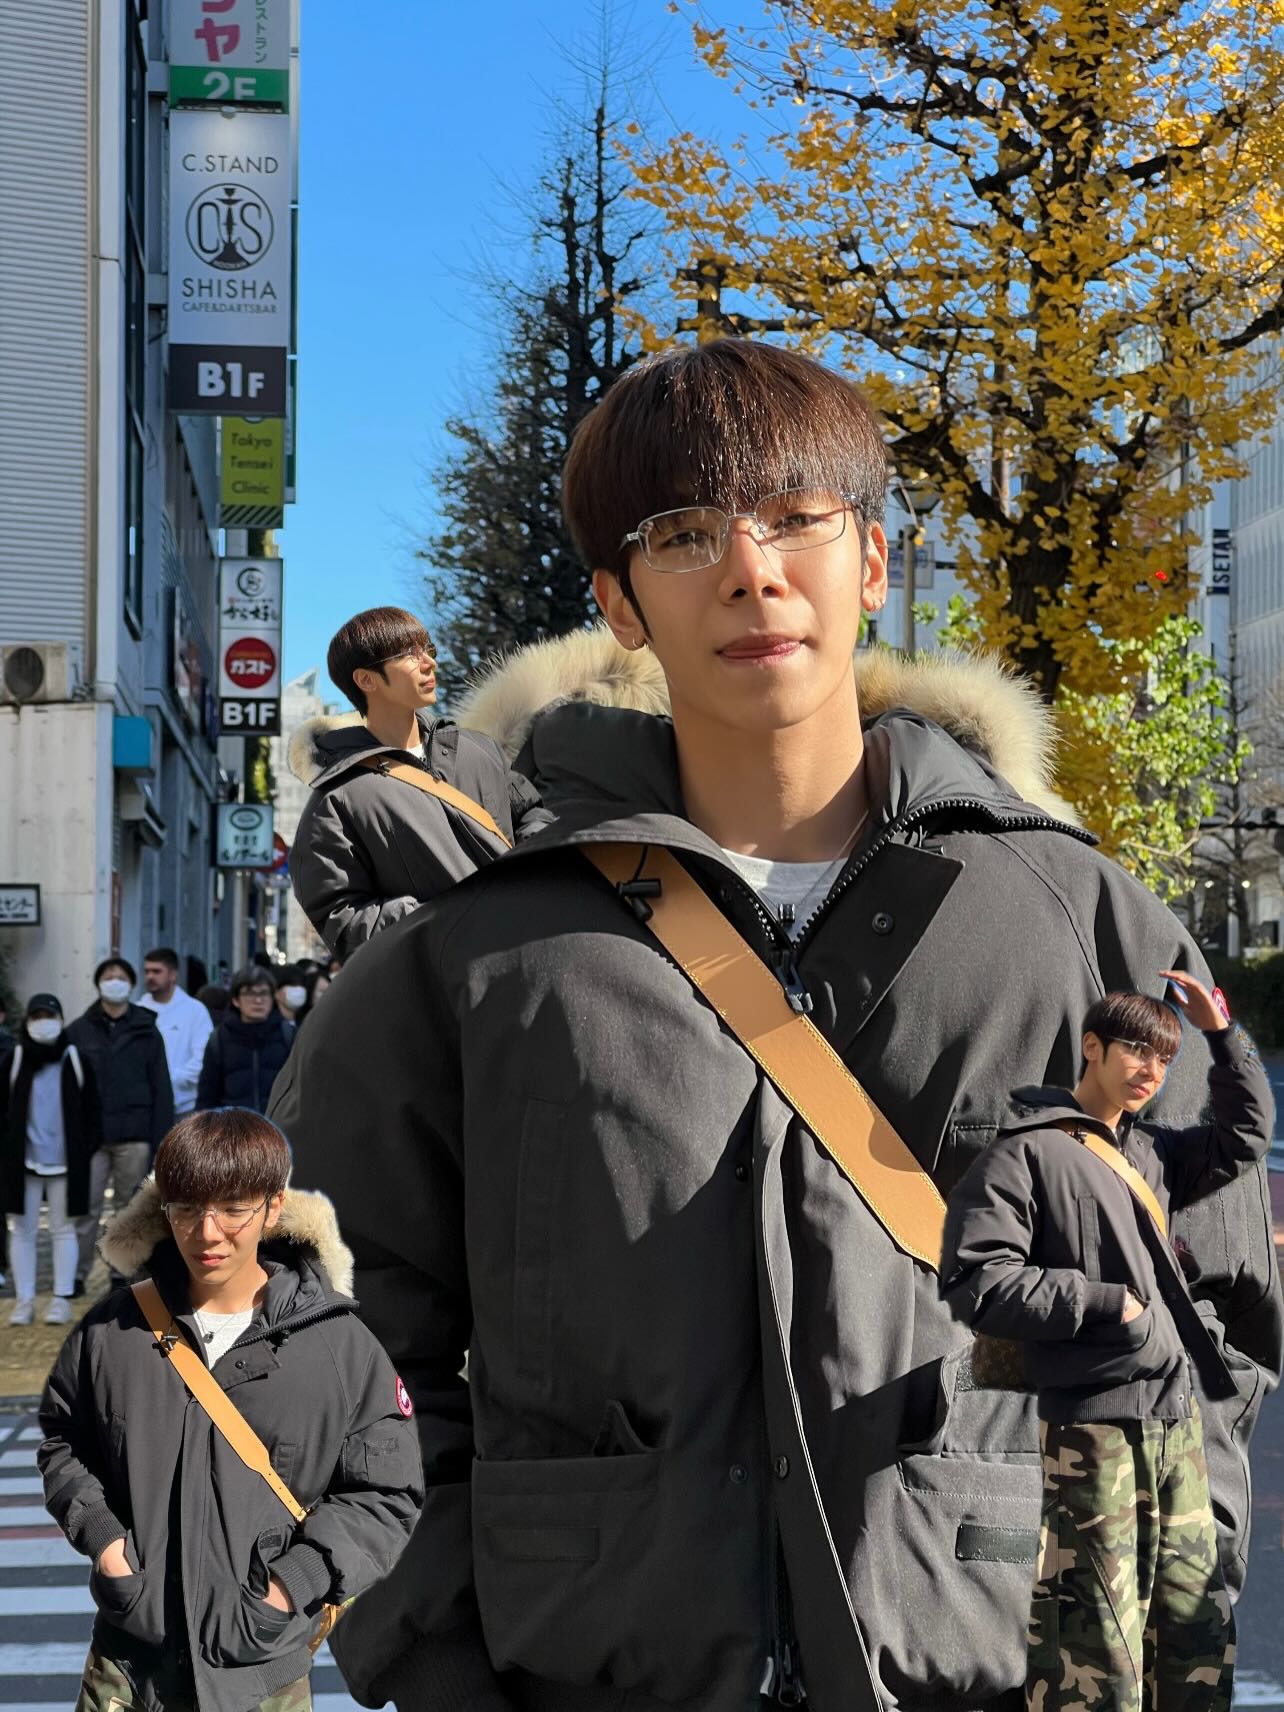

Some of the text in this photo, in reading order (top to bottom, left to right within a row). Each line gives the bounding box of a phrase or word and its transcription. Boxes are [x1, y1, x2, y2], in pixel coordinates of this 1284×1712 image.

[203, 71, 256, 100] 2F
[182, 153, 279, 174] C.STAND
[181, 277, 277, 300] SHISHA
[197, 361, 265, 398] B1F
[231, 432, 272, 450] Tokyo
[231, 480, 270, 494] Clinic
[230, 659, 273, 676] ガスト
[222, 701, 277, 726] B1F
